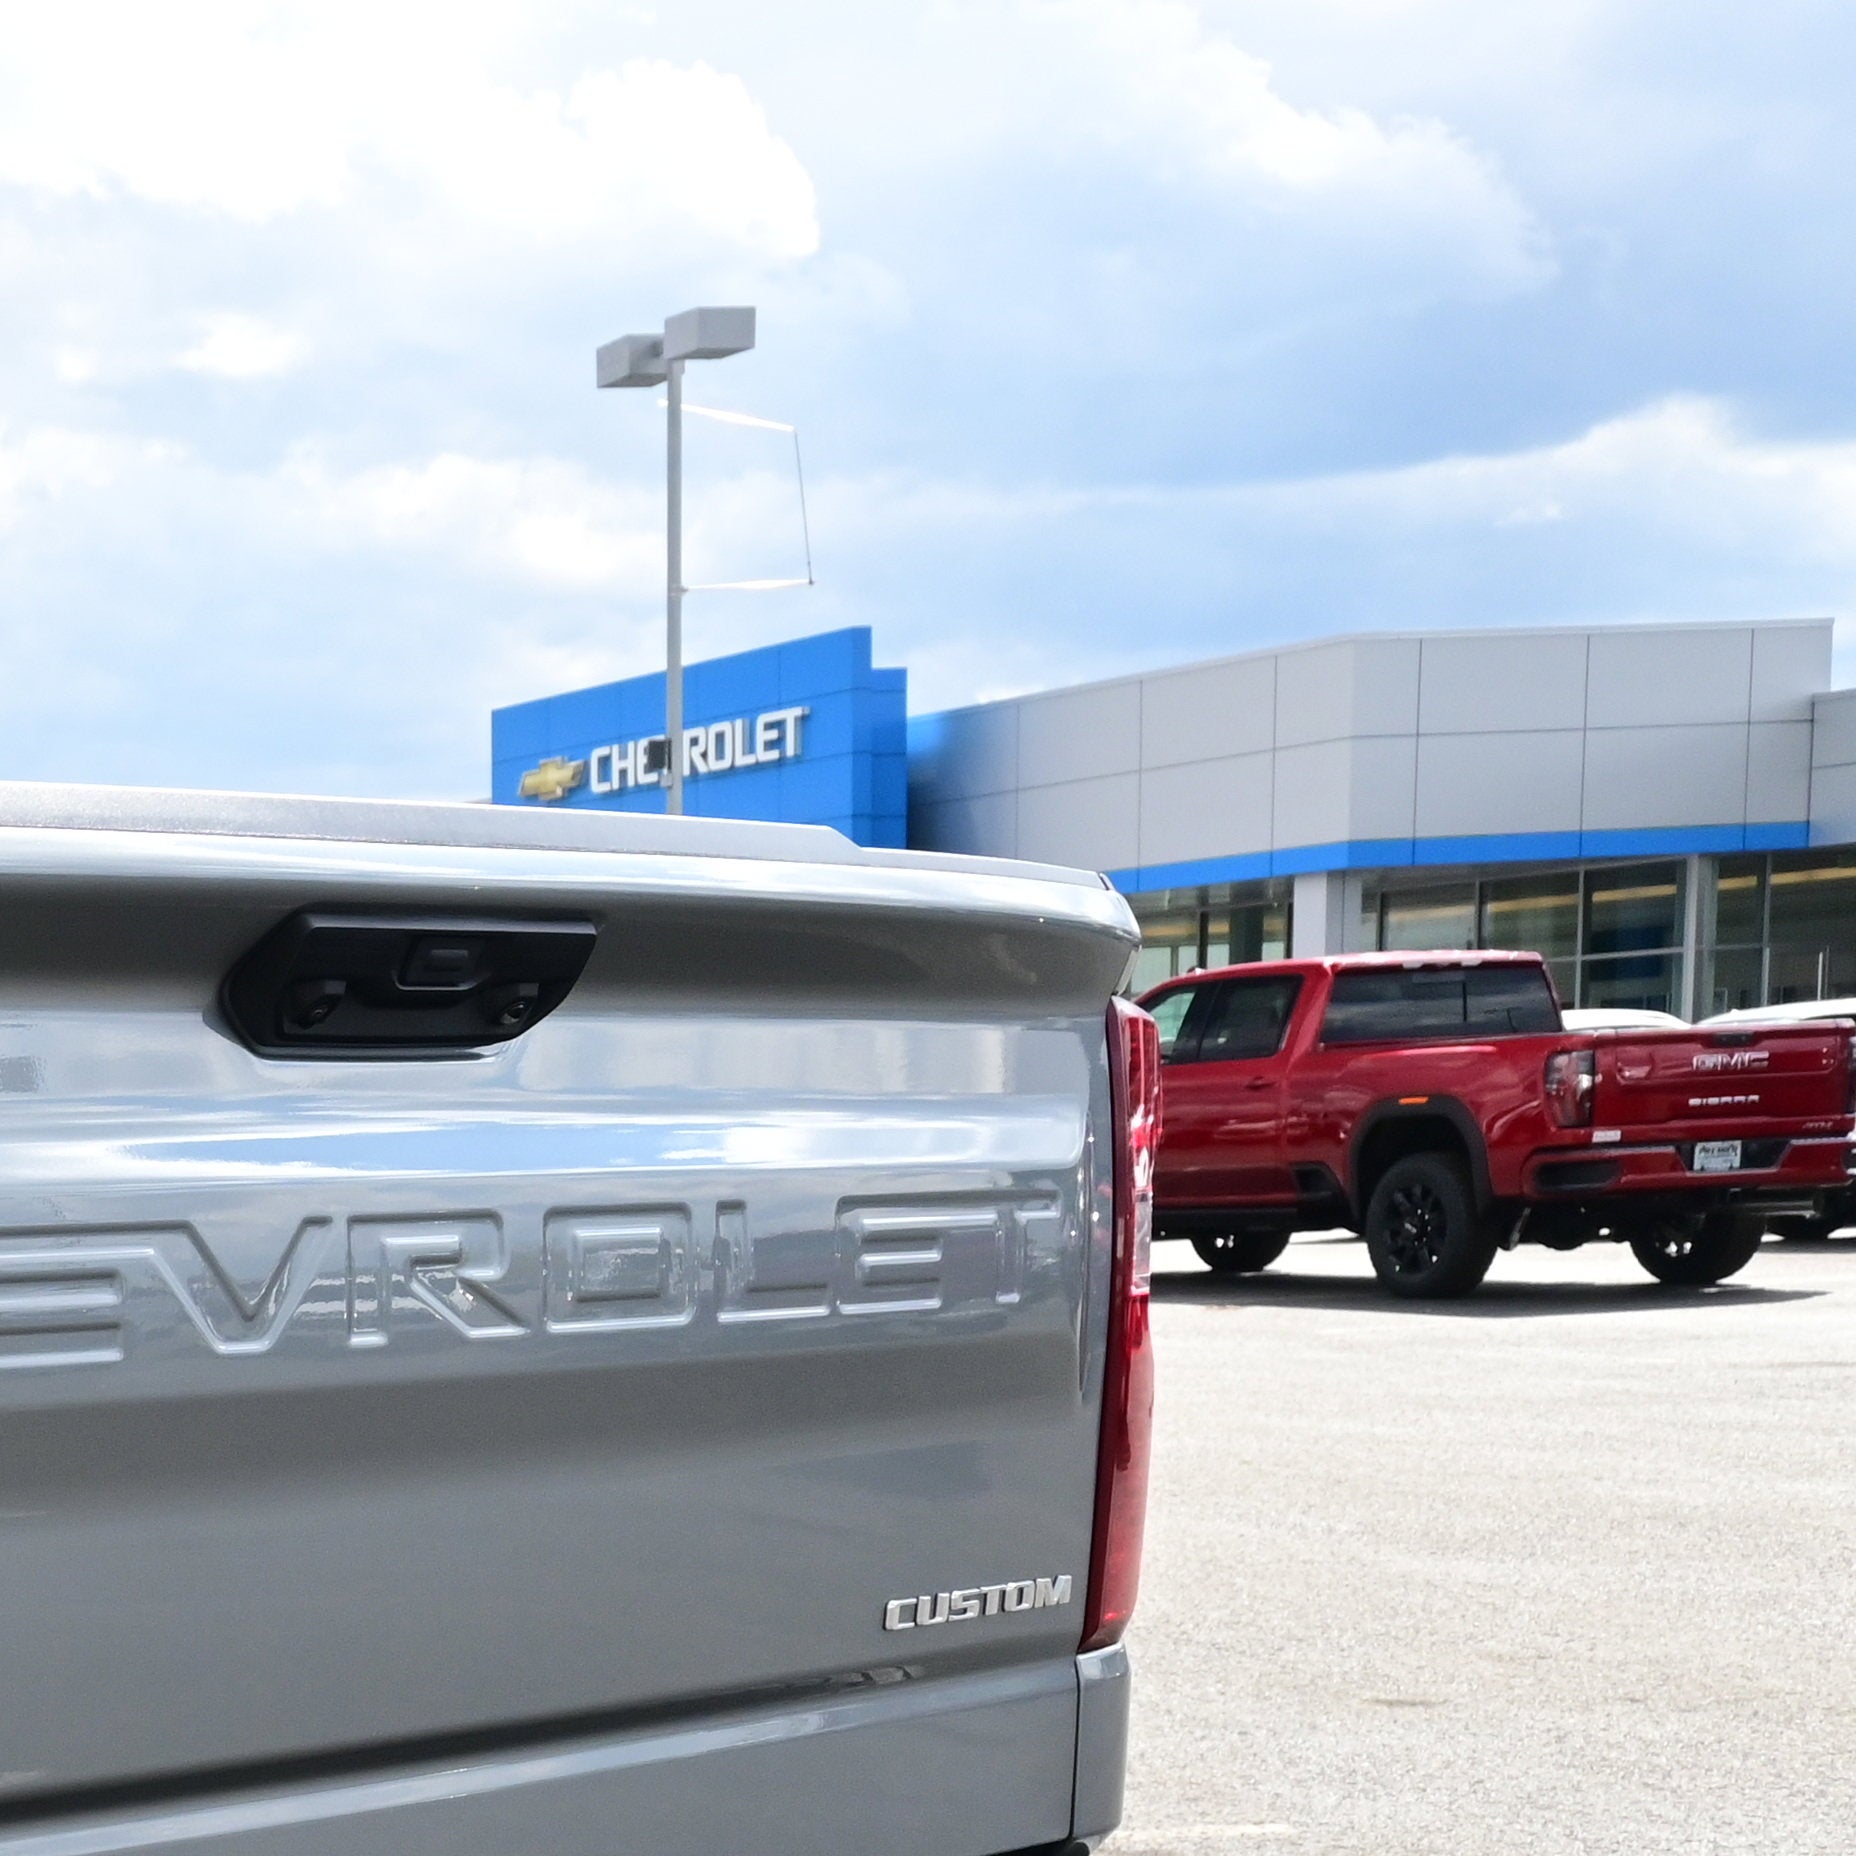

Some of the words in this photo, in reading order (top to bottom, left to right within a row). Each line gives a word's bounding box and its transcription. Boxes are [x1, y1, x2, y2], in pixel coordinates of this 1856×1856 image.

[590, 706, 809, 794] CHEROLET
[1692, 1051, 1769, 1071] GMC
[883, 1574, 1073, 1631] CUSTOM
